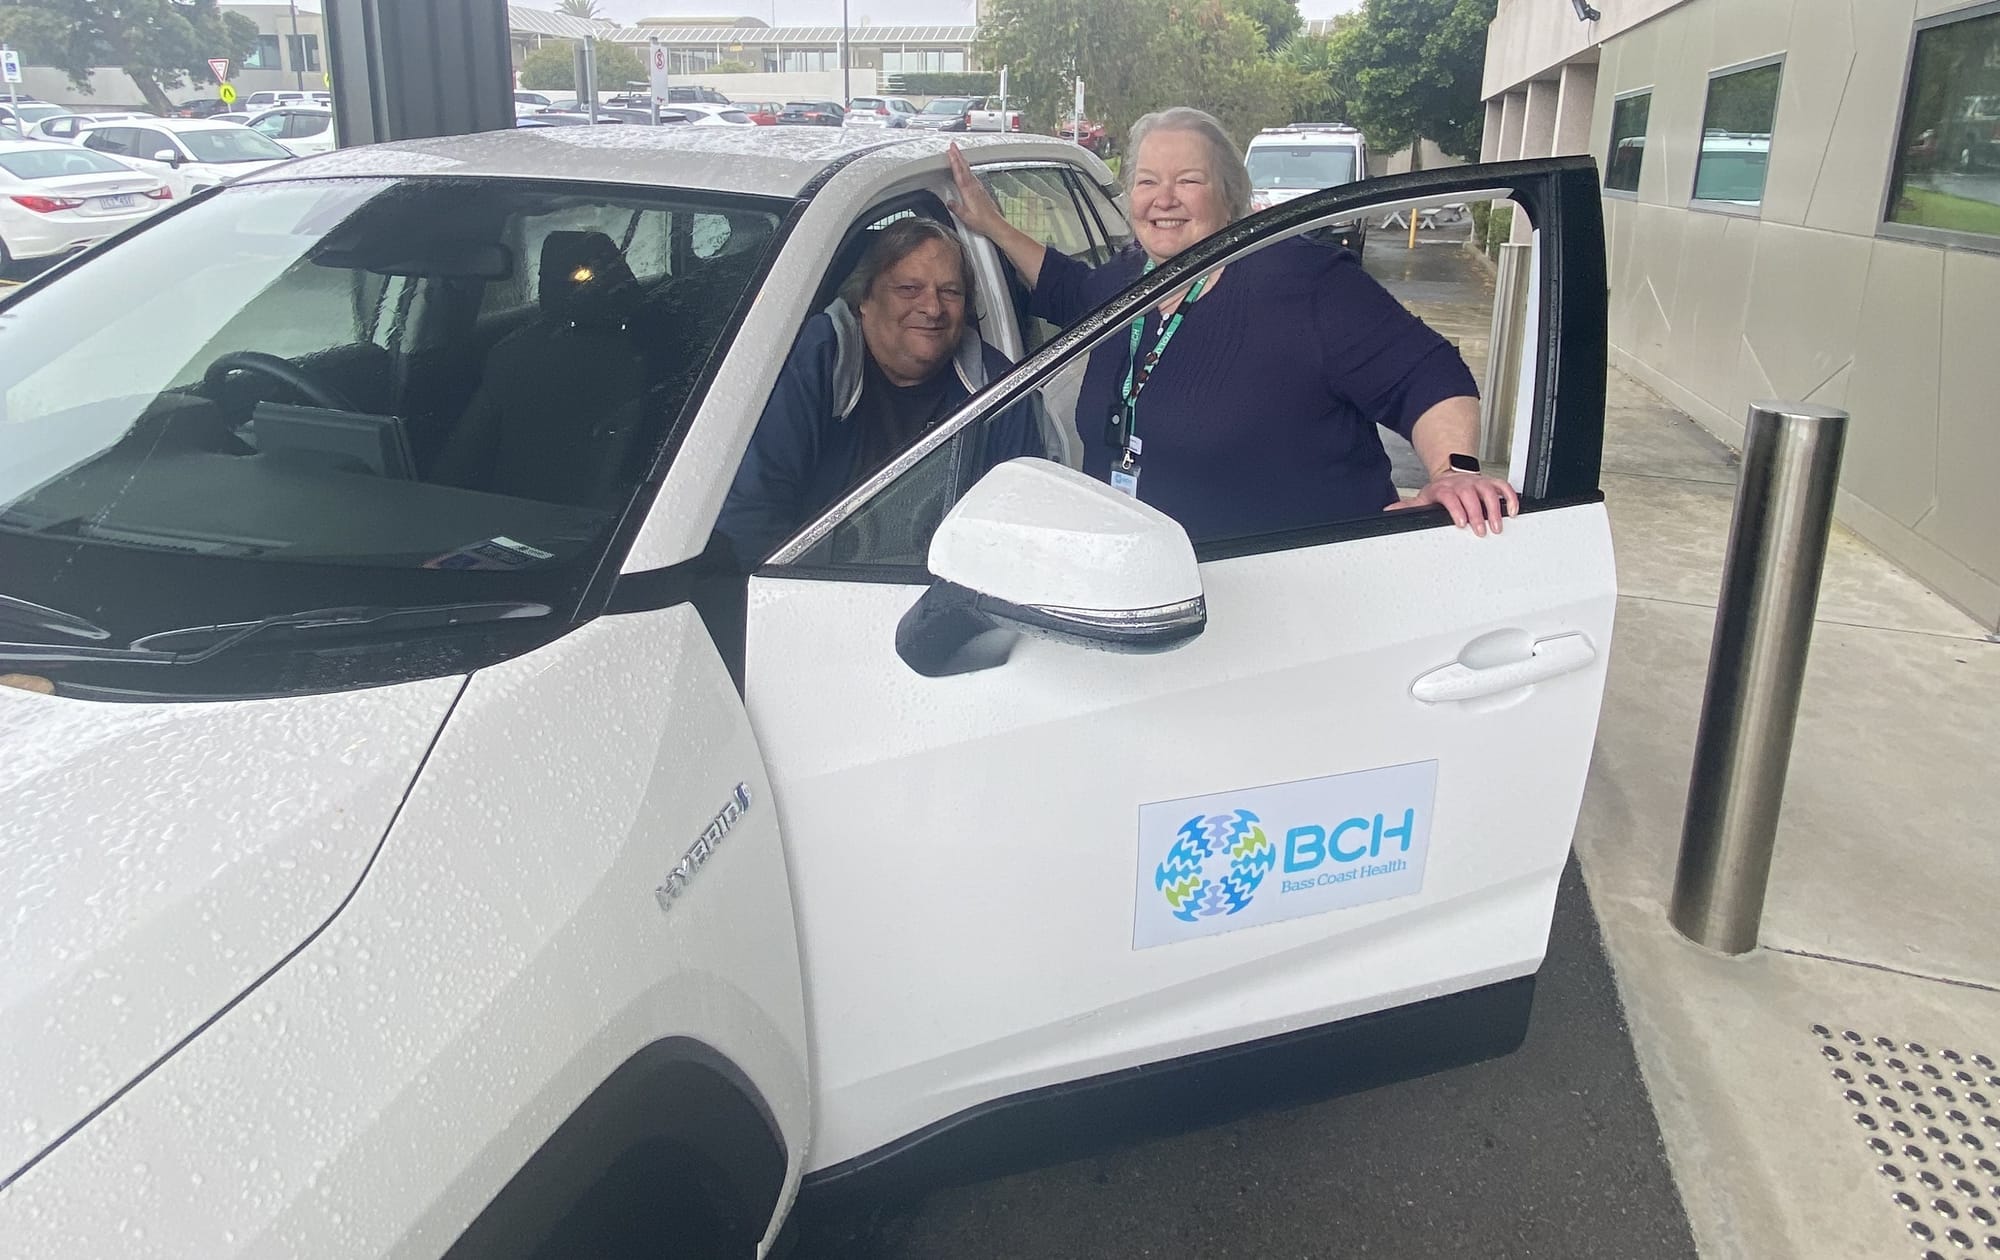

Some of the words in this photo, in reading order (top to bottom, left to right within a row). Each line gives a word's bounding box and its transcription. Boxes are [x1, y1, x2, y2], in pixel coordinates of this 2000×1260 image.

[655, 800, 739, 912] HYBRID
[1283, 808, 1414, 873] BCH
[1281, 879, 1315, 894] Bass
[1317, 868, 1358, 886] Coast
[1360, 859, 1407, 878] Health
